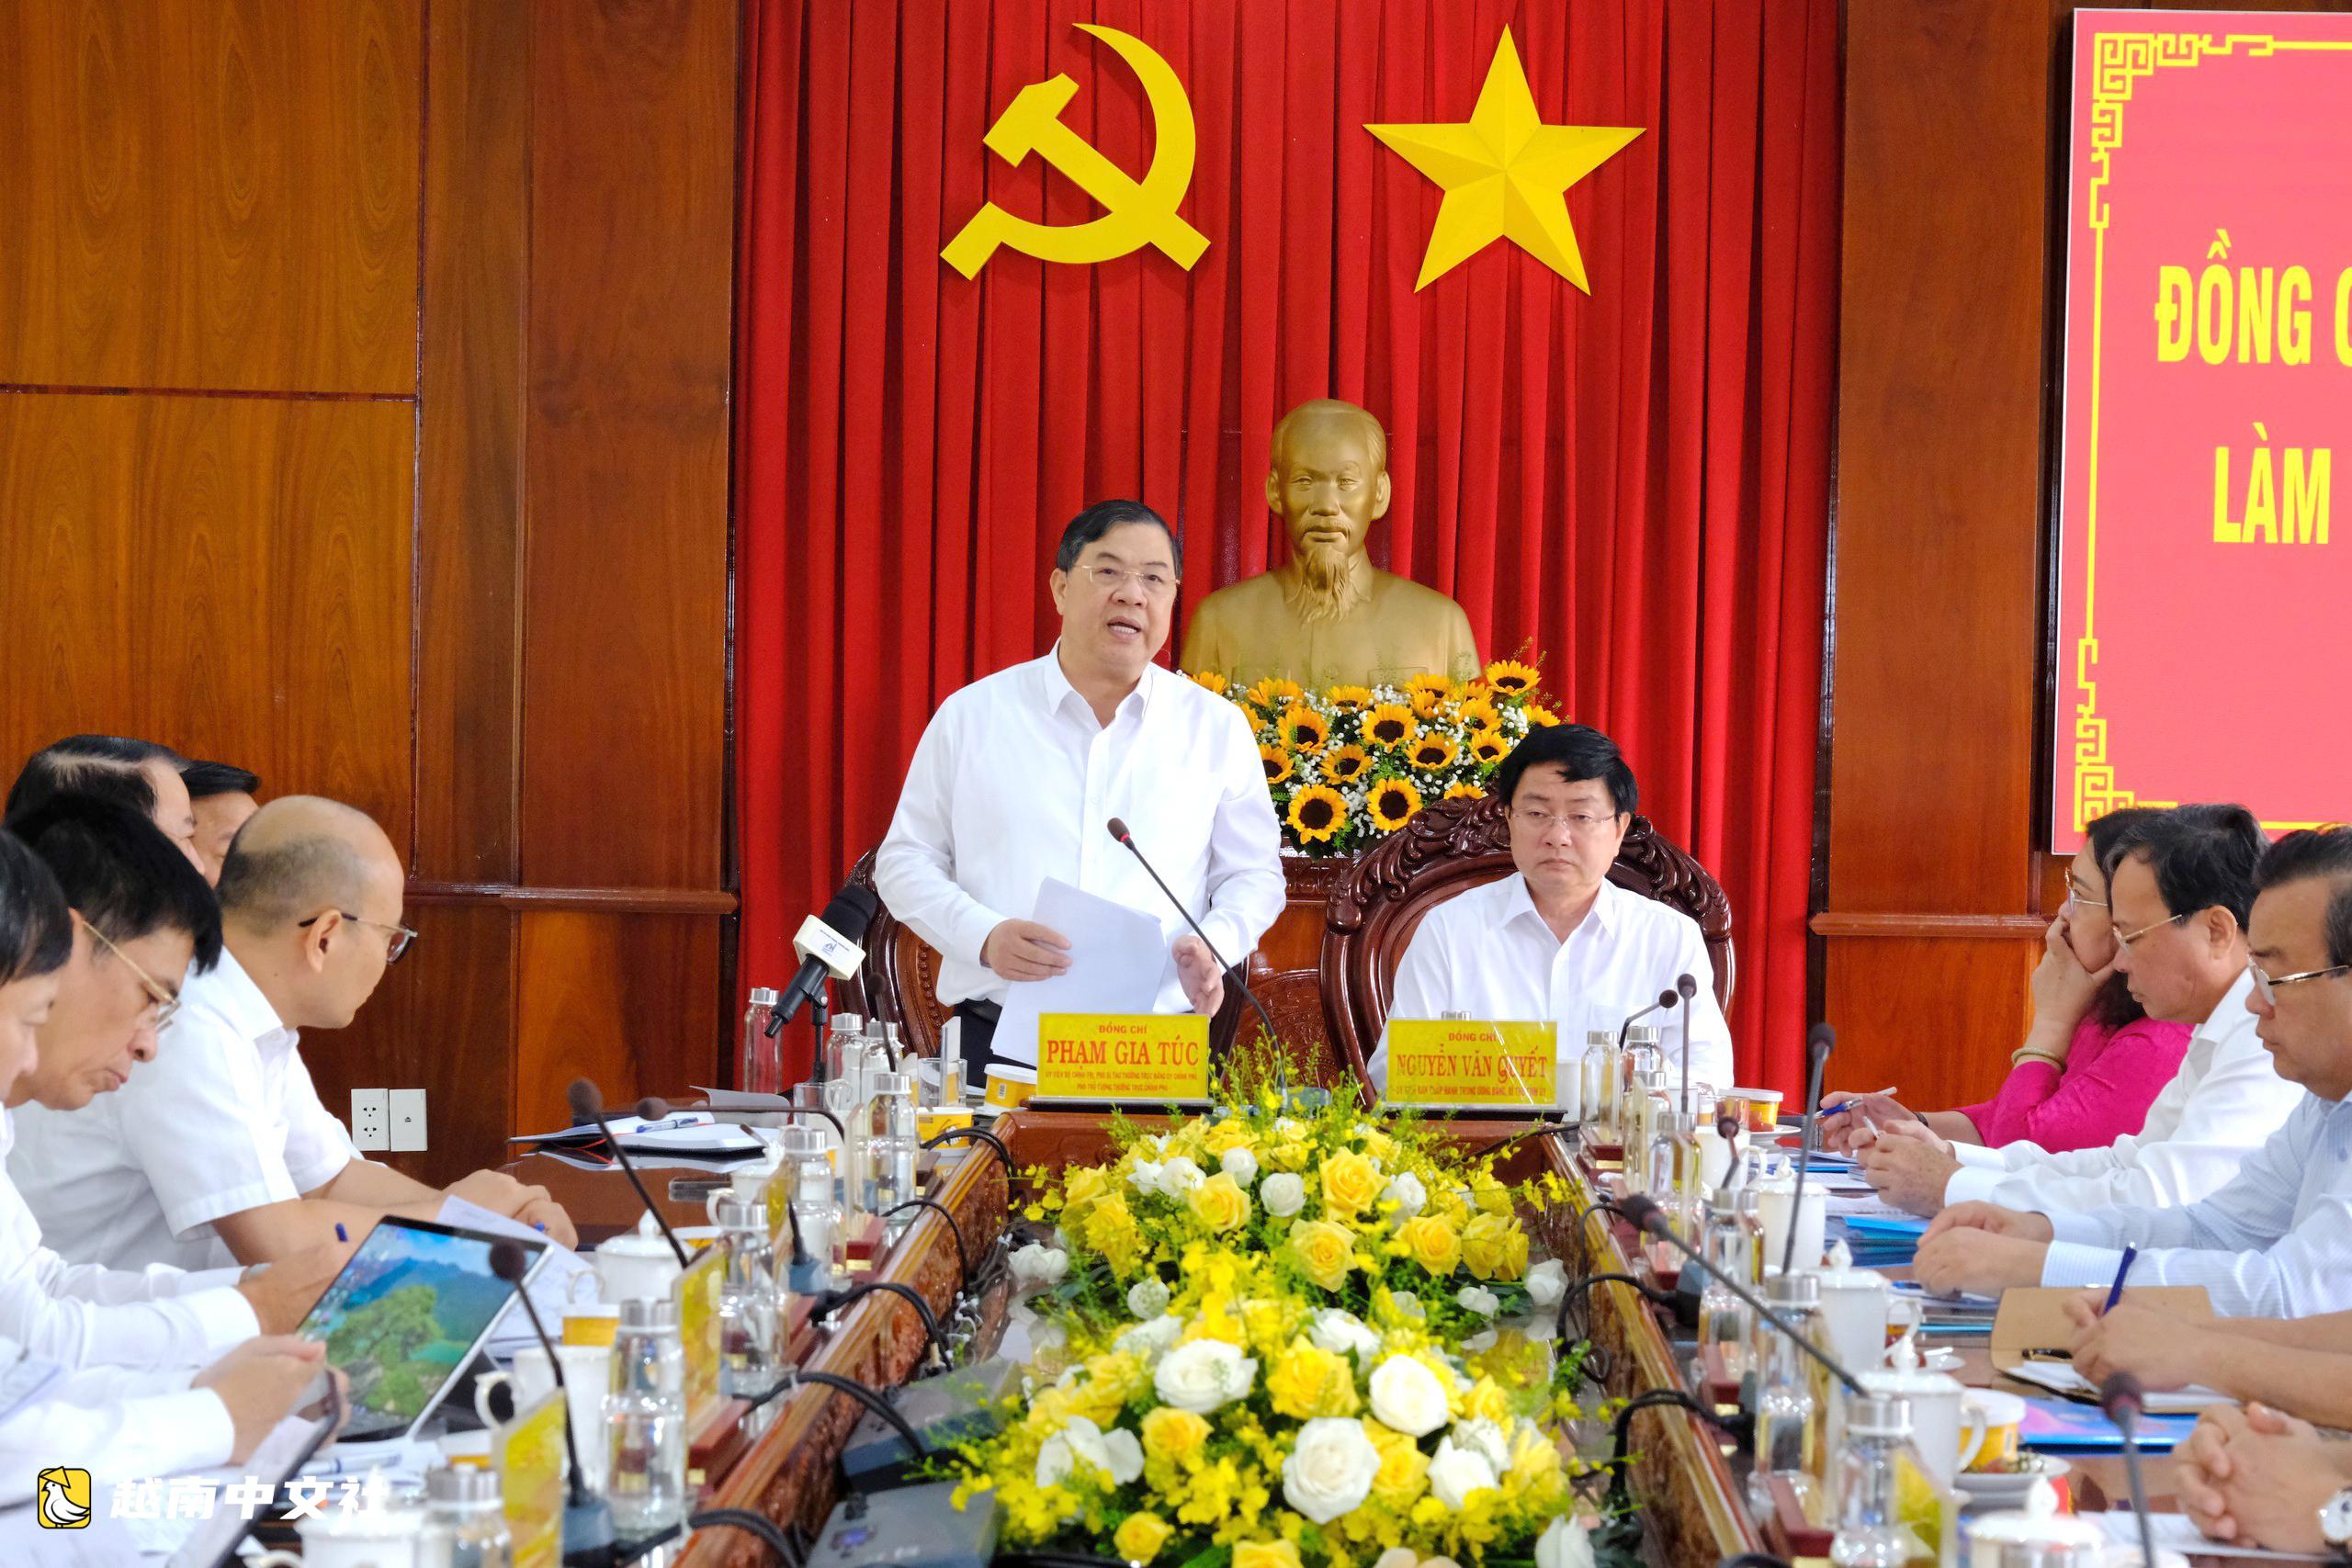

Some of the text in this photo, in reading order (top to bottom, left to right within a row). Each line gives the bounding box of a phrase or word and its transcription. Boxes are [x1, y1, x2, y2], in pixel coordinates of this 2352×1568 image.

[2154, 229, 2312, 366] ĐỒNG
[2213, 423, 2331, 544] LÀM
[1046, 1034, 1199, 1070] PHẠM GIA TÚC
[1463, 1050, 1492, 1077] VĂN
